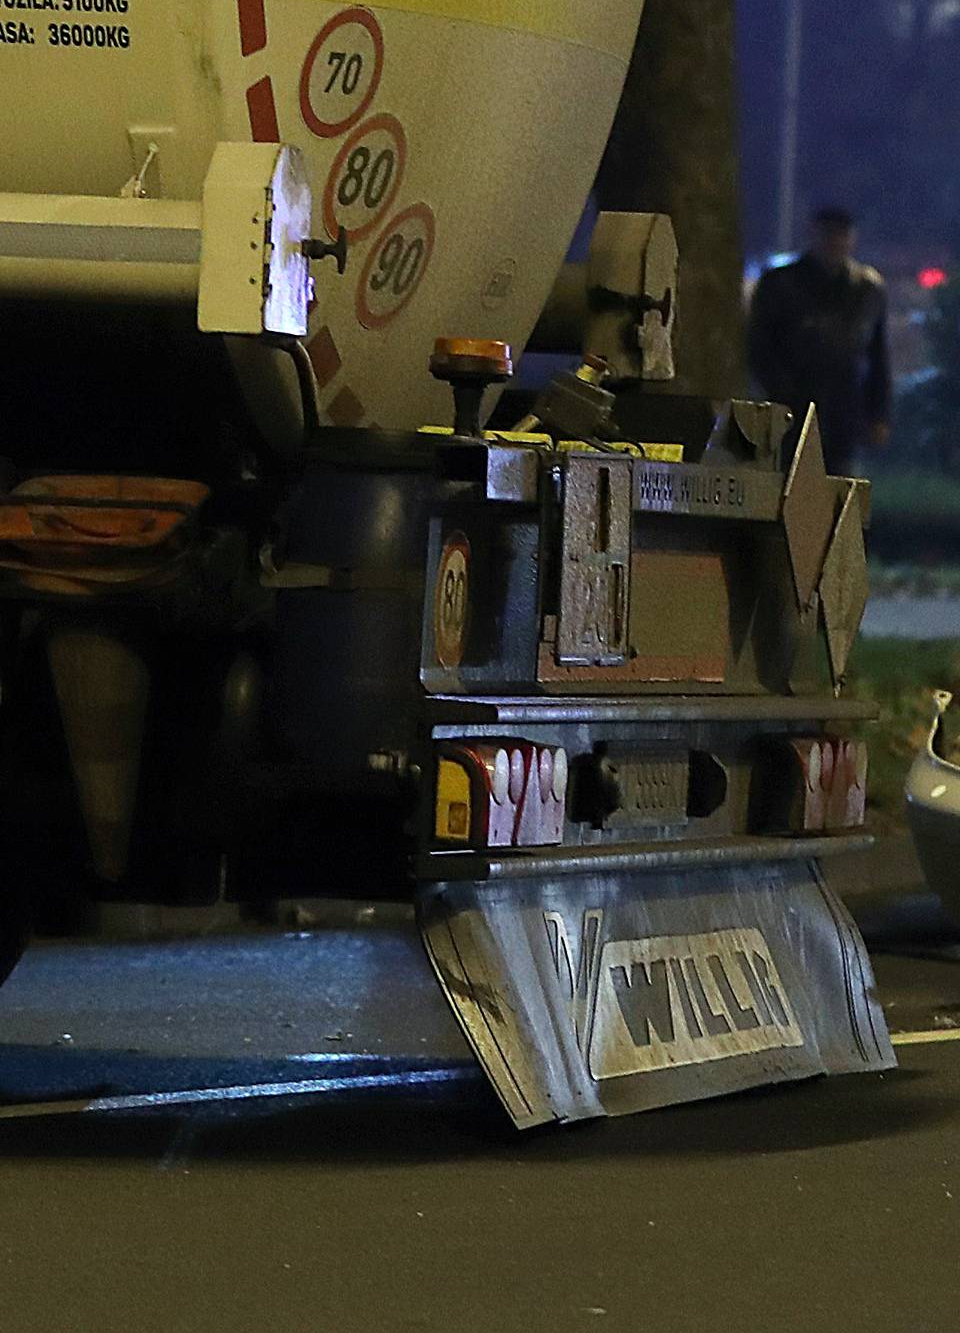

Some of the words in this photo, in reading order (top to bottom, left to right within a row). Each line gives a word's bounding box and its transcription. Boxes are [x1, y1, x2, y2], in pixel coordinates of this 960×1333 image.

[48, 23, 130, 48] 36000KG
[324, 52, 363, 95] 70
[337, 146, 395, 209] 80
[370, 233, 425, 296] 90
